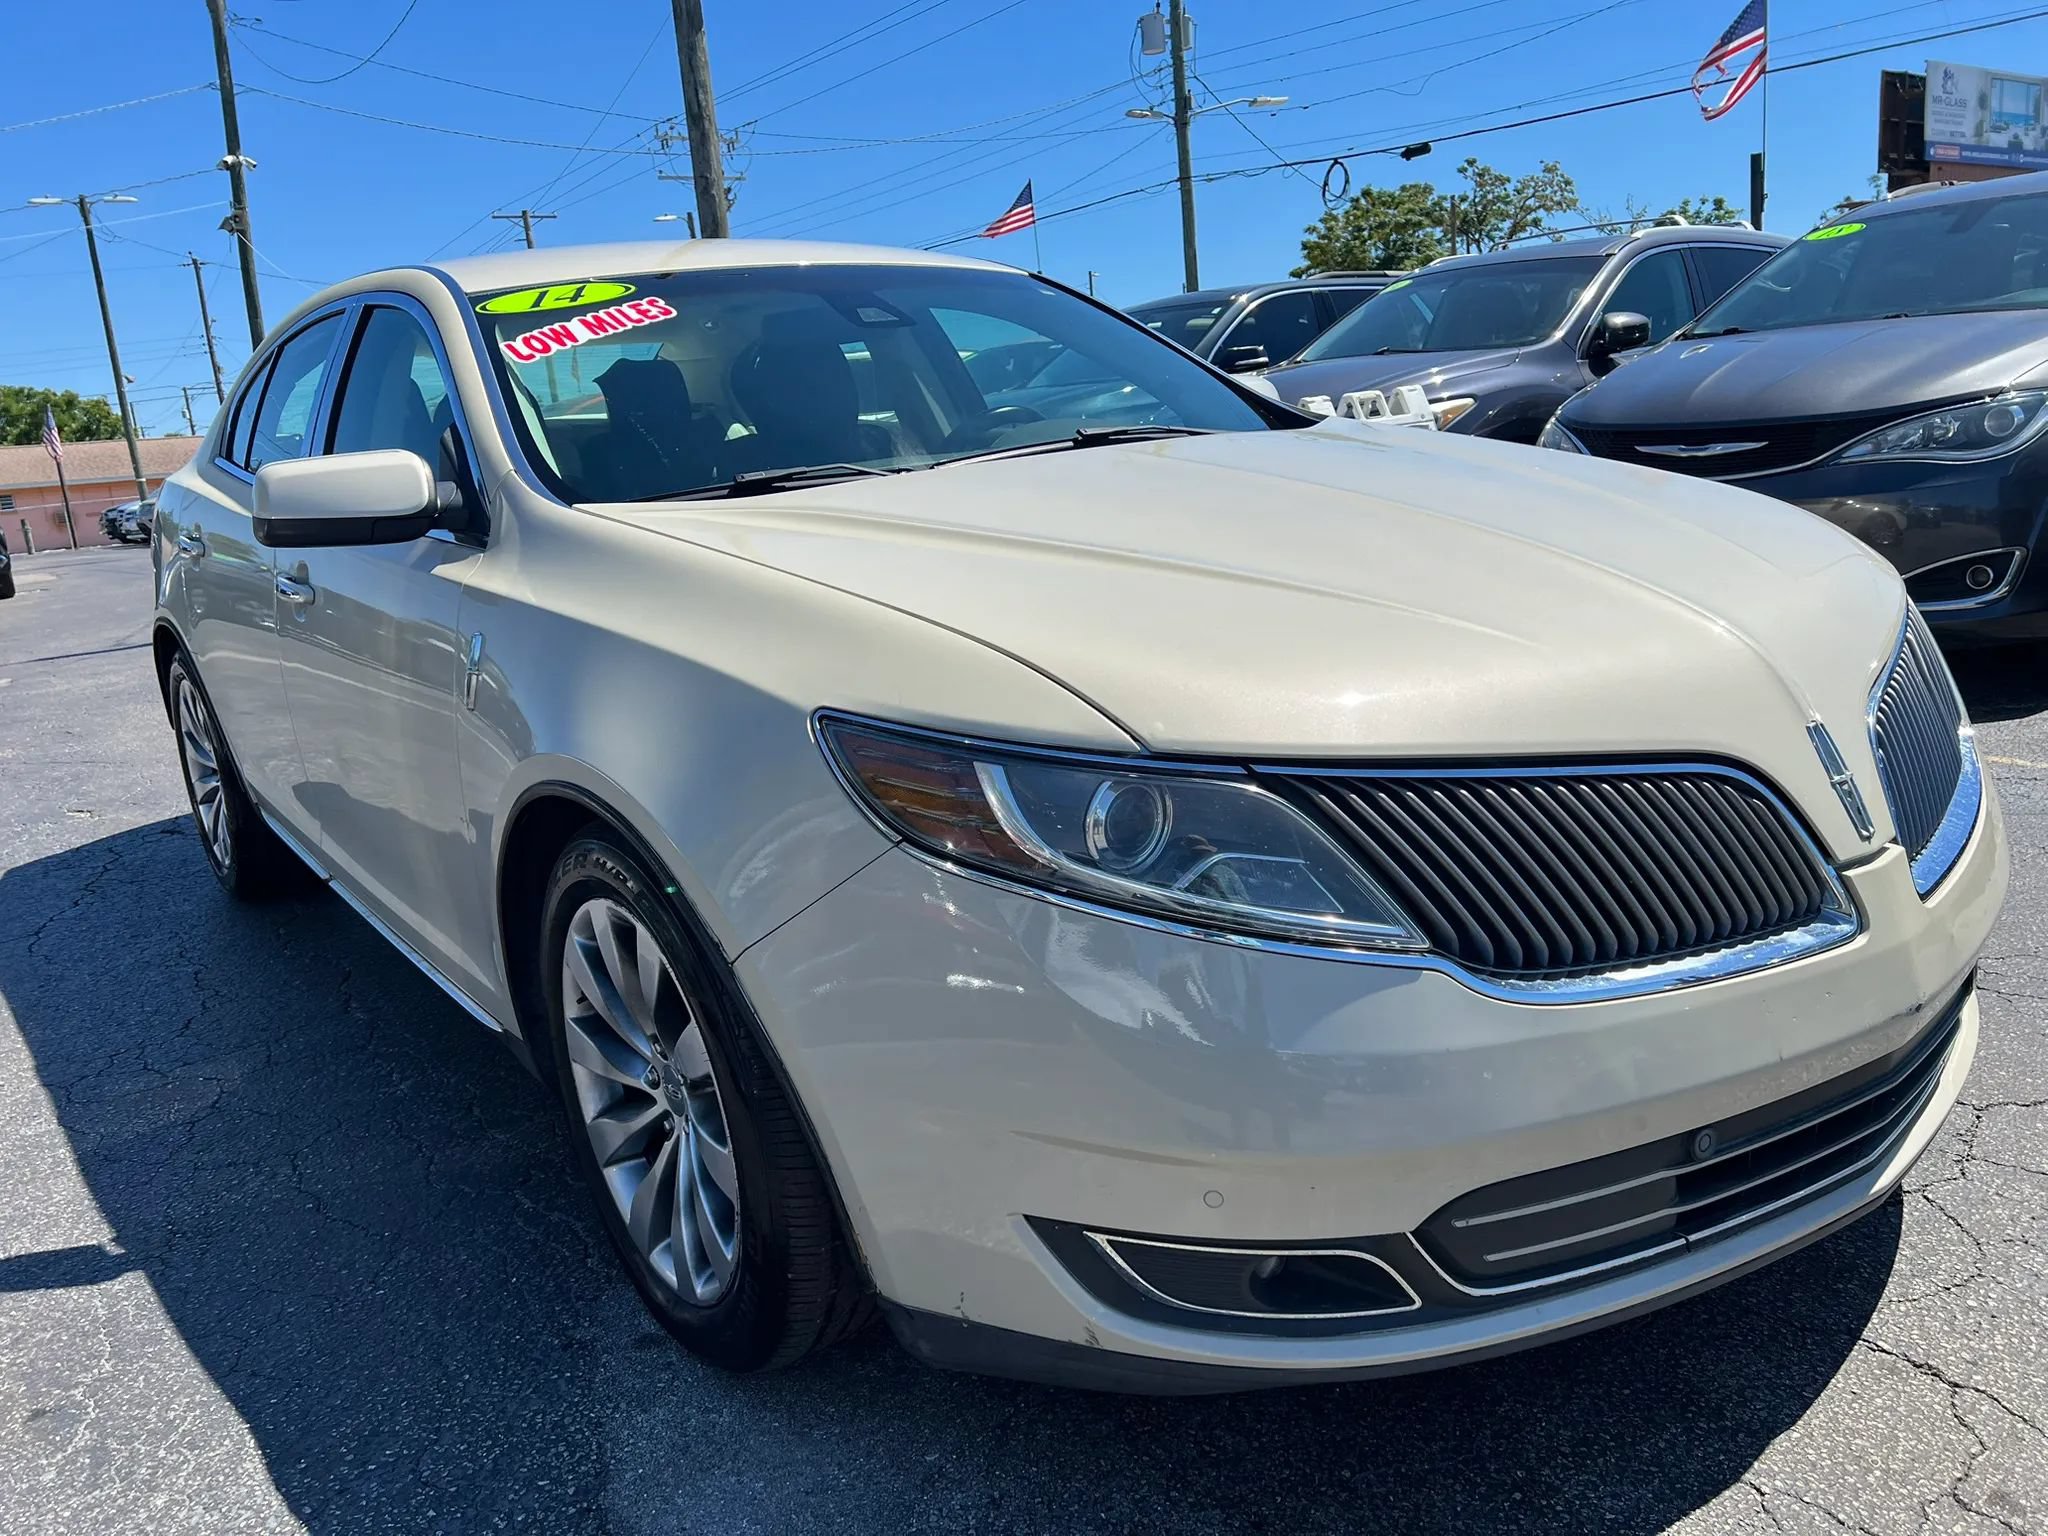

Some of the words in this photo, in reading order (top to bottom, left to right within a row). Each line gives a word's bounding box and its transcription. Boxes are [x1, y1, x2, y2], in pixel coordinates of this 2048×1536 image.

[1944, 96, 1968, 108] GLASS
[530, 284, 586, 310] 14
[504, 323, 580, 362] LOW
[577, 299, 674, 336] MILES
